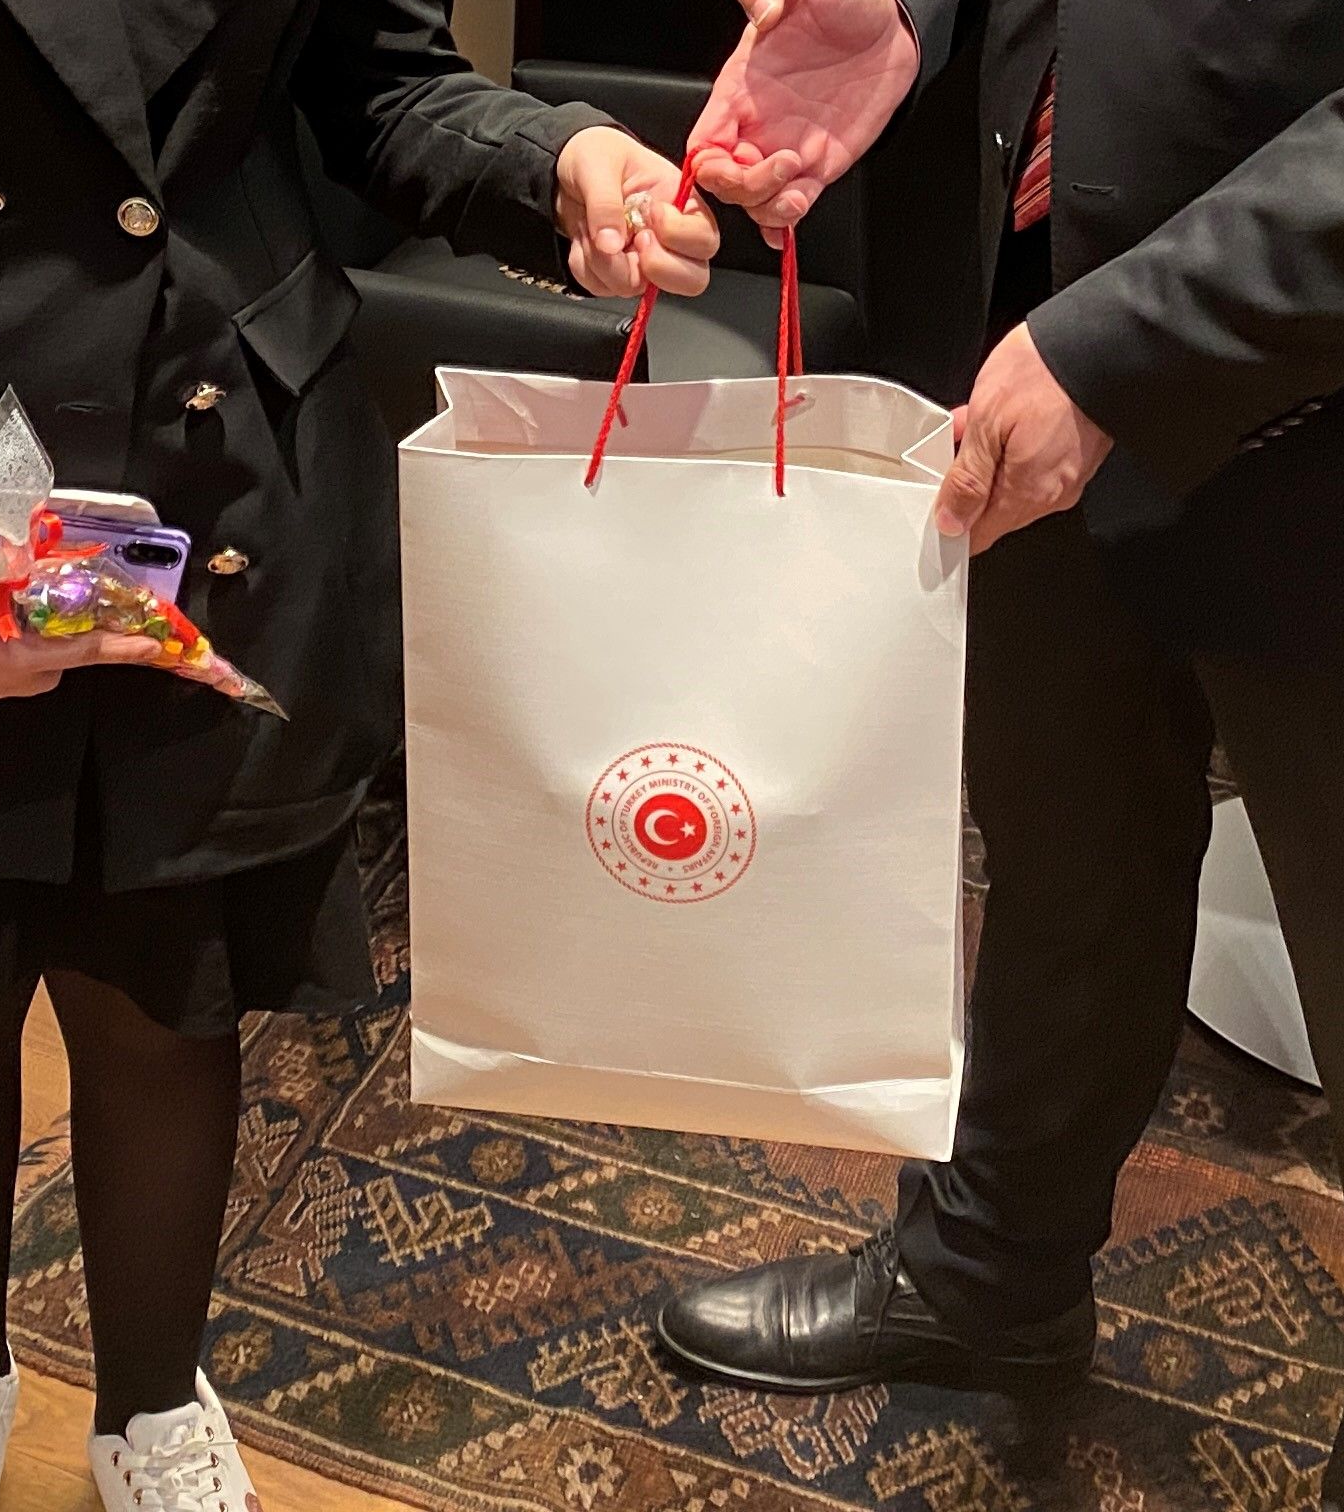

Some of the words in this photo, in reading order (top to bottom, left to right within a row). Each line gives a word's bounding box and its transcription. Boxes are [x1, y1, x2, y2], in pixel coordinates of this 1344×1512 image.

[648, 778, 698, 793] MINISTRY
[620, 784, 648, 817] TURKEY
[697, 792, 711, 808] OF
[619, 820, 628, 832] OF
[707, 805, 722, 849] FOREIGN
[621, 833, 659, 870] REPUBLIC
[682, 848, 716, 874] AFFAIRS
